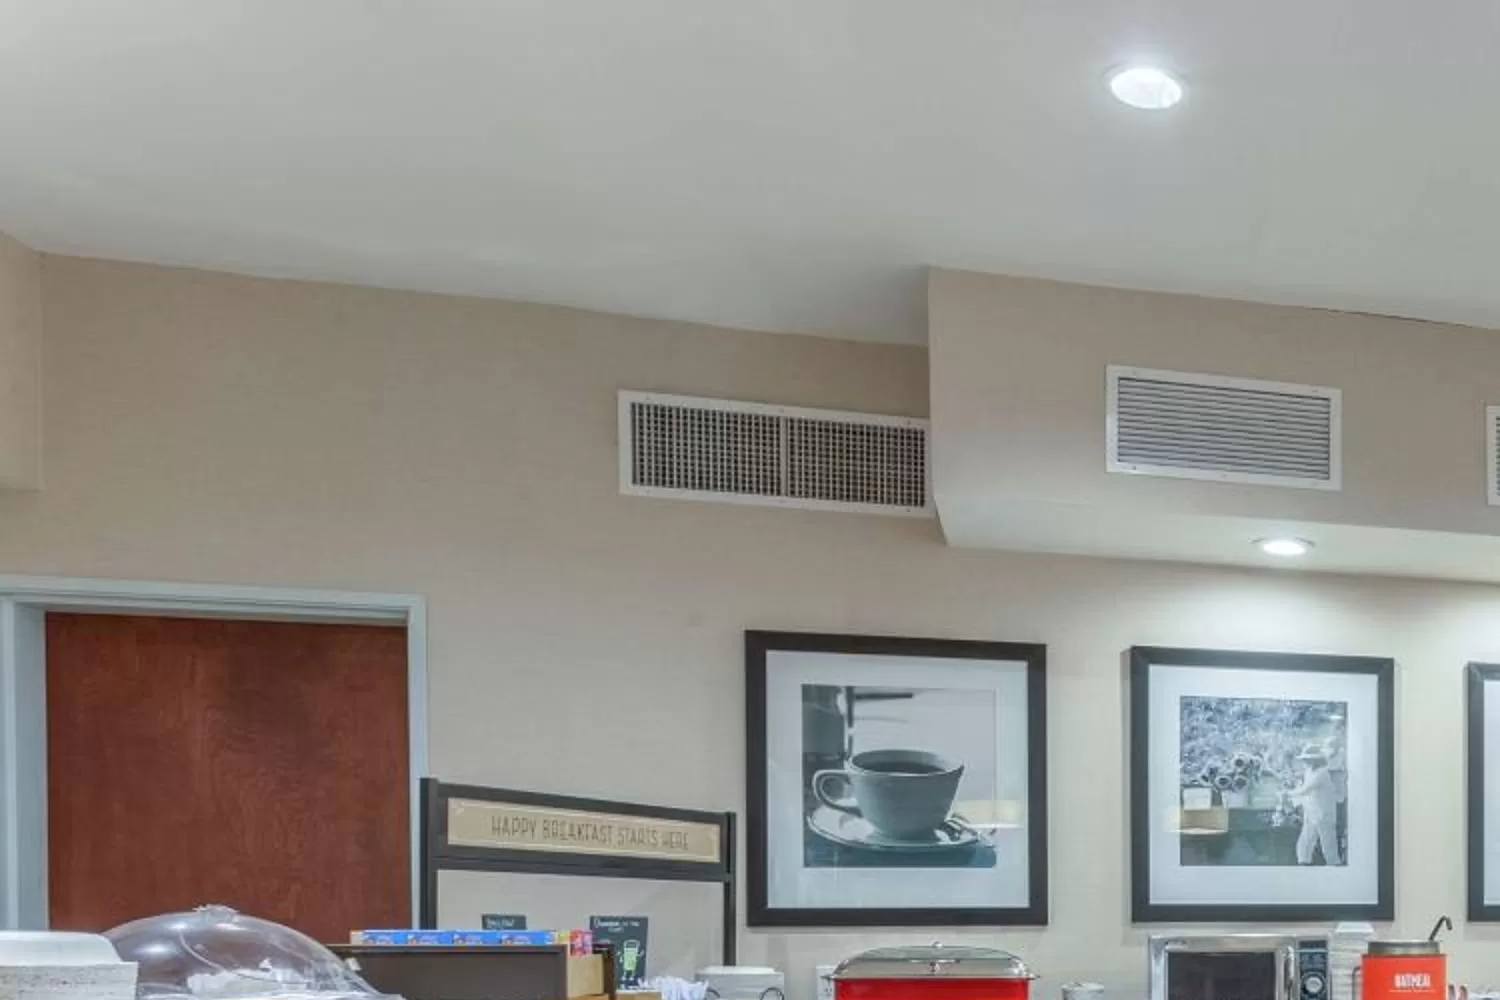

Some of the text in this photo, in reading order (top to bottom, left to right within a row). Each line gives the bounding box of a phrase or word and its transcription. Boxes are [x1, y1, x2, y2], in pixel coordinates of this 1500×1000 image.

[491, 815, 688, 851] HAPPY BREAKFAST STARTS HERE
